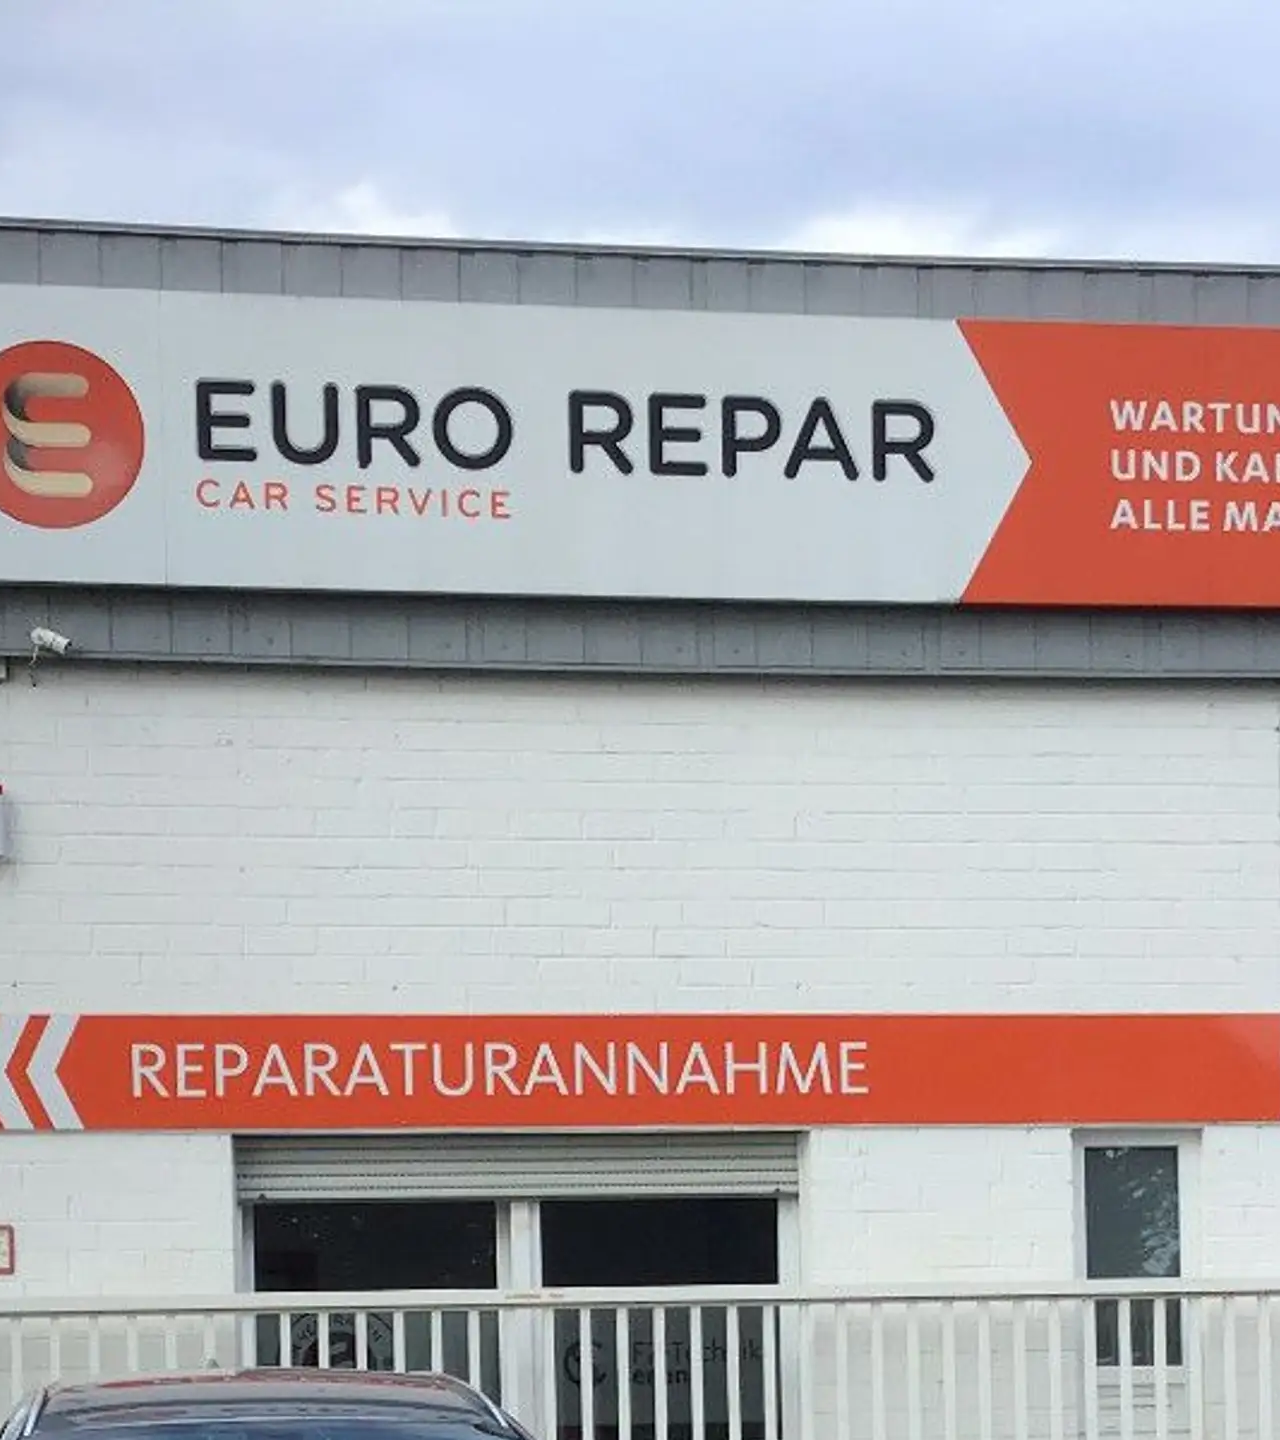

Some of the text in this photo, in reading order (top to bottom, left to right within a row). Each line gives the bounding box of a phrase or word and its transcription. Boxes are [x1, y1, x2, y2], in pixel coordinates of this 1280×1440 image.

[195, 377, 935, 484] EURO REPAR
[1110, 448, 1201, 483] UND
[195, 478, 512, 520] CAR SERVICE
[1110, 498, 1210, 532] ALLE
[130, 1040, 870, 1099] REPARATURANNAHME
